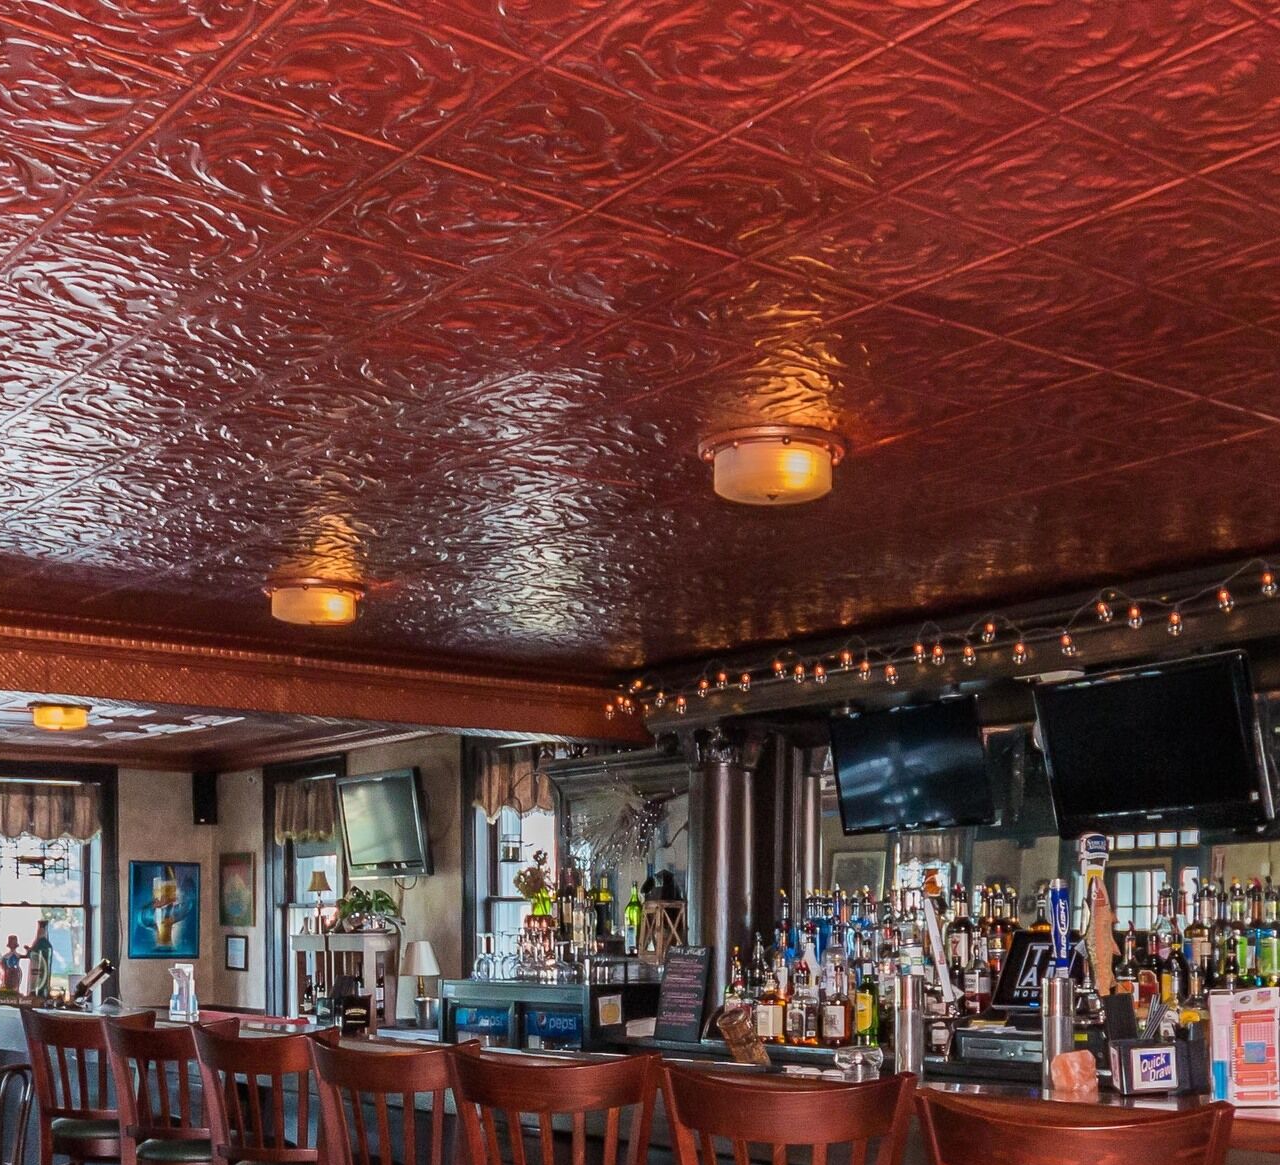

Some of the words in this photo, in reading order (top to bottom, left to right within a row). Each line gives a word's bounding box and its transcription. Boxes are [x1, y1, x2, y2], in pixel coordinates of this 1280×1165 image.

[1059, 899, 1067, 935] LIGHT
[549, 1017, 577, 1031] pepsi
[1142, 1053, 1166, 1072] Quick
[1150, 1065, 1172, 1081] Draw
